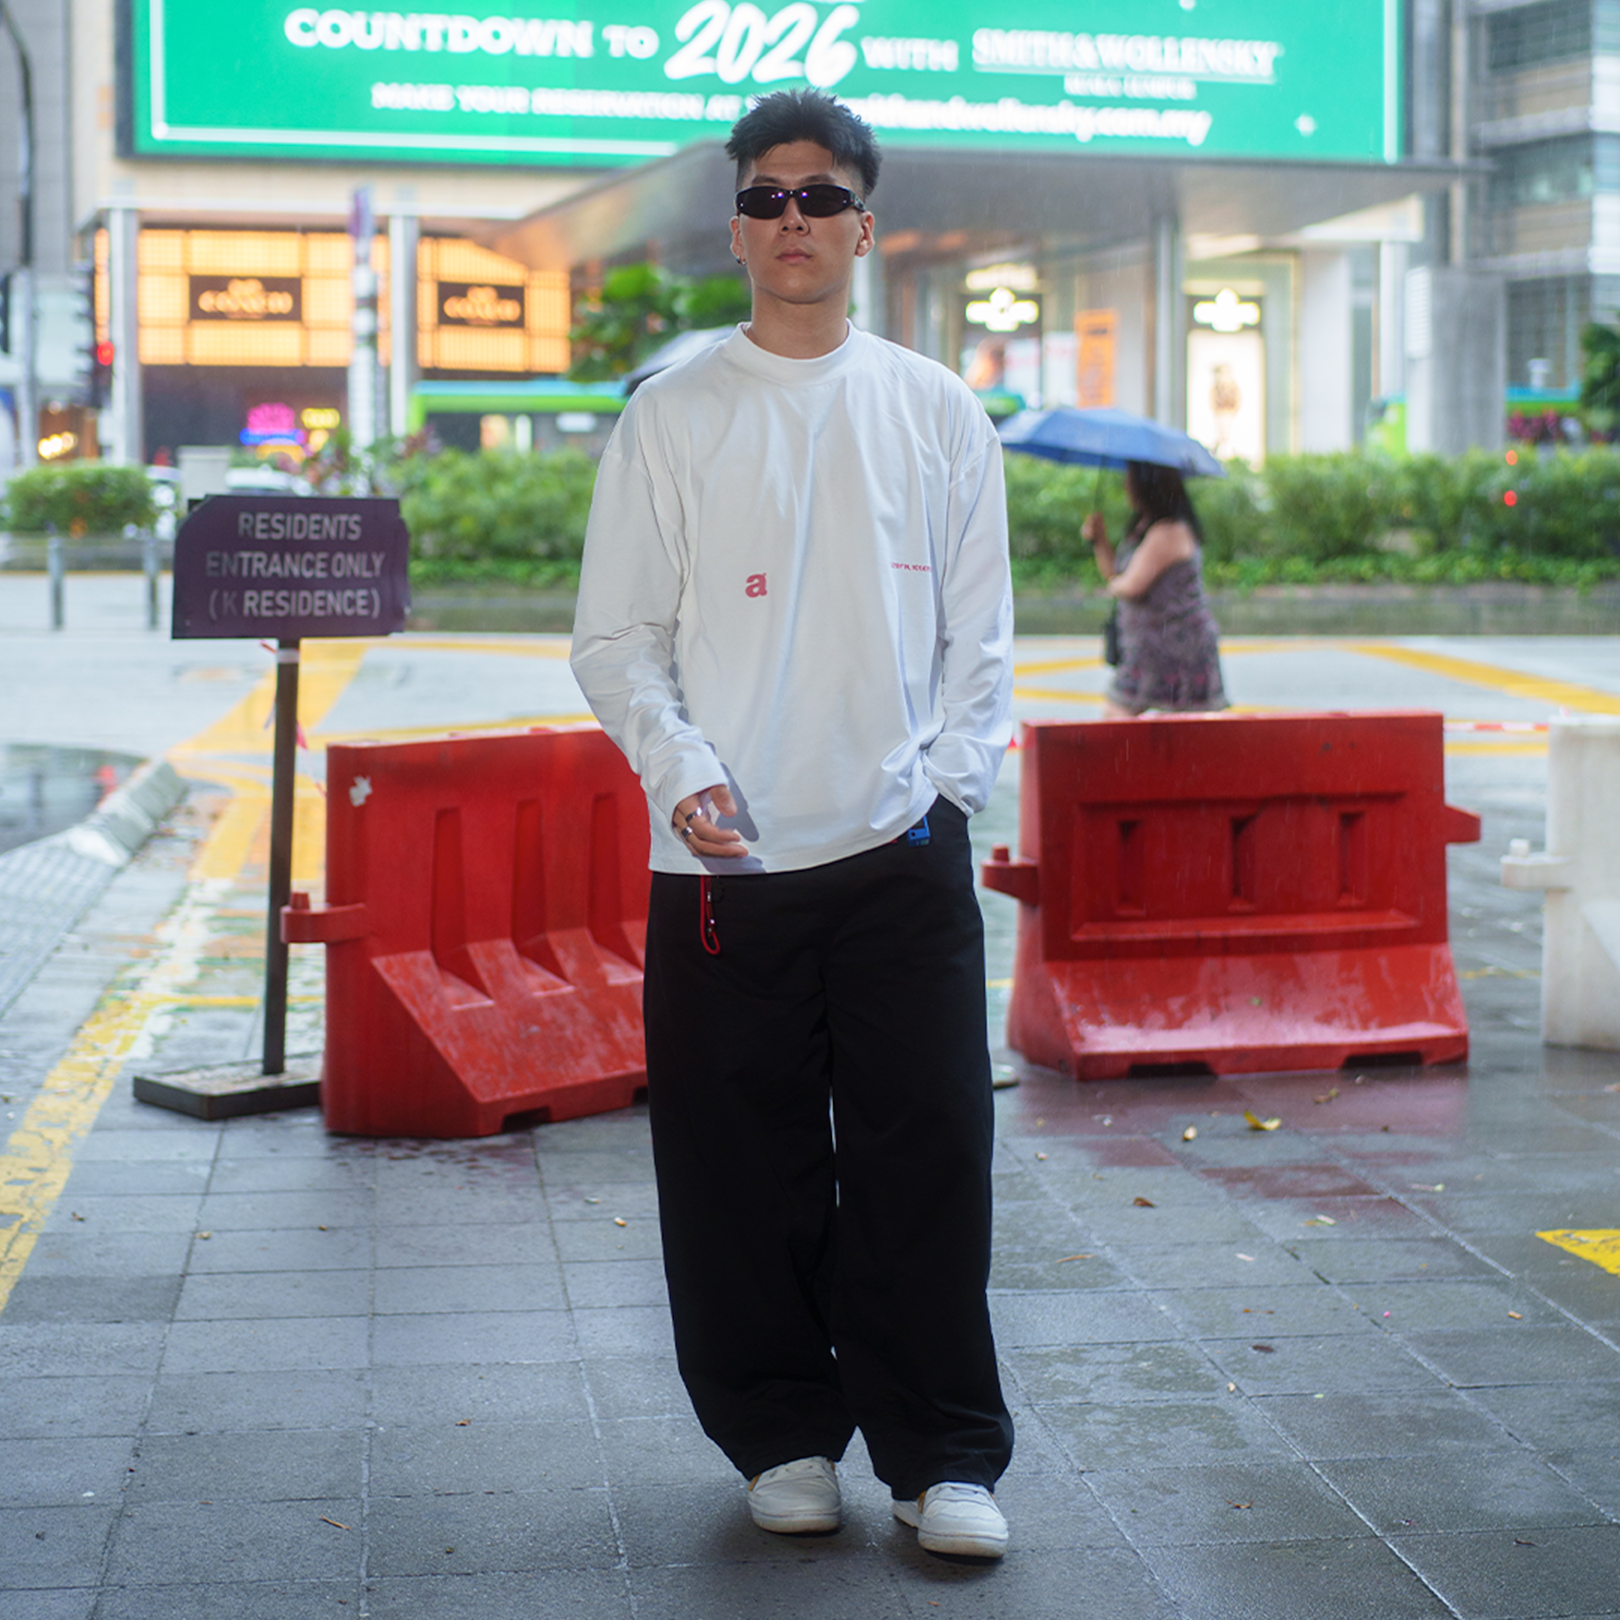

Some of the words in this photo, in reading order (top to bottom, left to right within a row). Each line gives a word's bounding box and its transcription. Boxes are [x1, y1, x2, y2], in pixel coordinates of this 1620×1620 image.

[284, 9, 594, 58] COUNTDOWN
[602, 25, 660, 59] TO
[664, 0, 860, 87] 2026
[861, 36, 959, 71] WITH
[238, 512, 362, 541] RESIDENTS
[205, 551, 329, 579] ENTRANCE
[331, 551, 385, 579] ONLY
[744, 572, 768, 599] a
